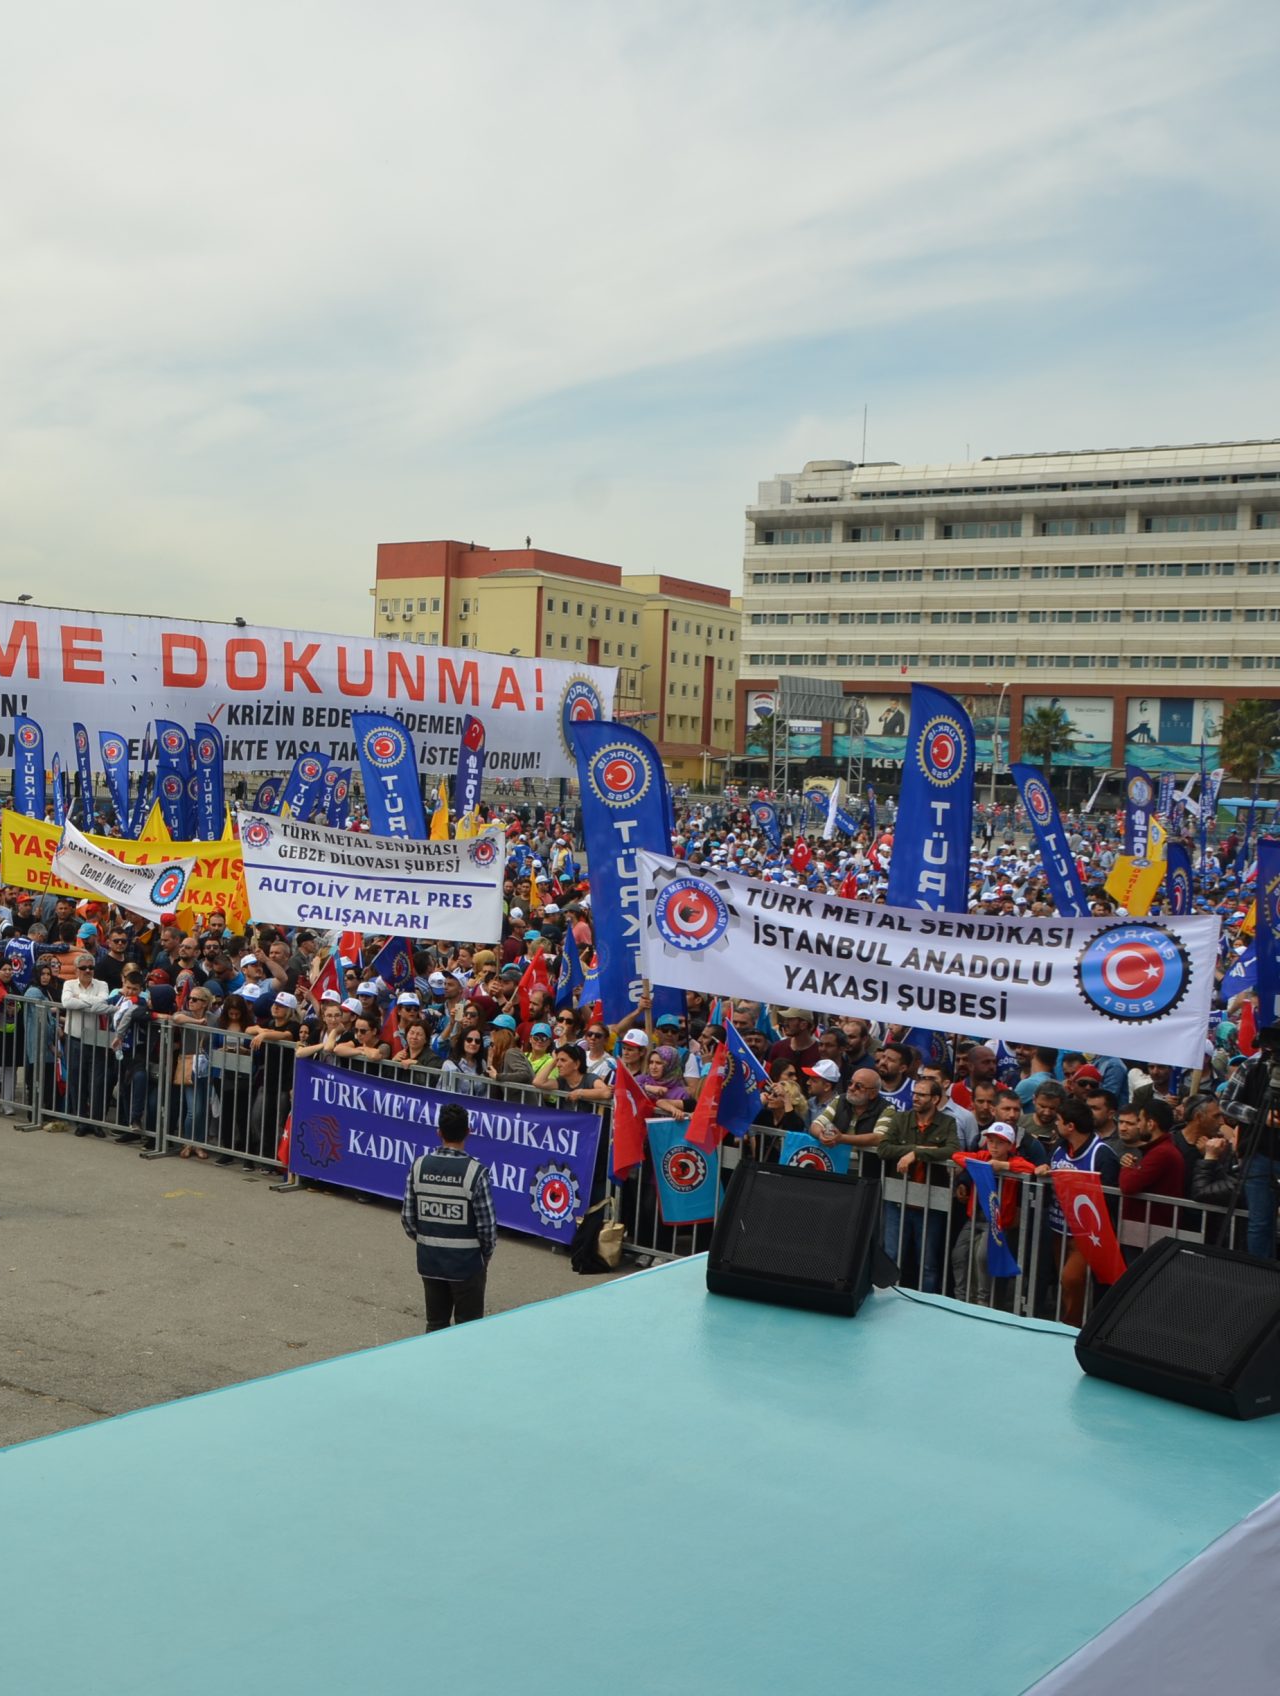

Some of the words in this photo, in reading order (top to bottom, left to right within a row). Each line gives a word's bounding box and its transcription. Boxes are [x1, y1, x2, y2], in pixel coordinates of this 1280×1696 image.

[162, 633, 544, 711] DOKUNMA!
[227, 699, 295, 726] KRİZİN
[871, 758, 905, 769] KEY
[280, 822, 320, 843] TÜRK
[324, 832, 373, 850] METAL
[376, 837, 459, 856] SENDİKASI
[278, 844, 326, 863] GEBZE
[330, 849, 400, 870] DİLOVASI
[405, 855, 461, 875] ŞUBESİ
[81, 863, 105, 882] Genel
[103, 873, 136, 895] Merkezi
[258, 876, 350, 899] AUTOLİV
[354, 886, 420, 906] METAL
[428, 892, 473, 909] PRES
[656, 892, 670, 917] TÜRK
[667, 880, 697, 895] METAL
[297, 904, 429, 930] ÇALIŞANLARI
[747, 886, 814, 918] TÜRK
[821, 902, 912, 933] METAL
[919, 918, 1074, 949] SENDİKASI
[753, 914, 893, 966] İSTANBUL
[901, 947, 1054, 987] ANADOLU
[1095, 928, 1176, 961] TÜRK-İŞ
[783, 965, 889, 1006] YAKASI
[898, 983, 1008, 1023] ŞUBESİ
[1102, 995, 1156, 1013] 1952
[310, 1073, 367, 1112] TÜRK
[468, 1111, 580, 1158] ENDİKASI
[347, 1128, 417, 1166] KADIN
[422, 1172, 462, 1184] KOCAELİ
[420, 1200, 463, 1219] POLİS
